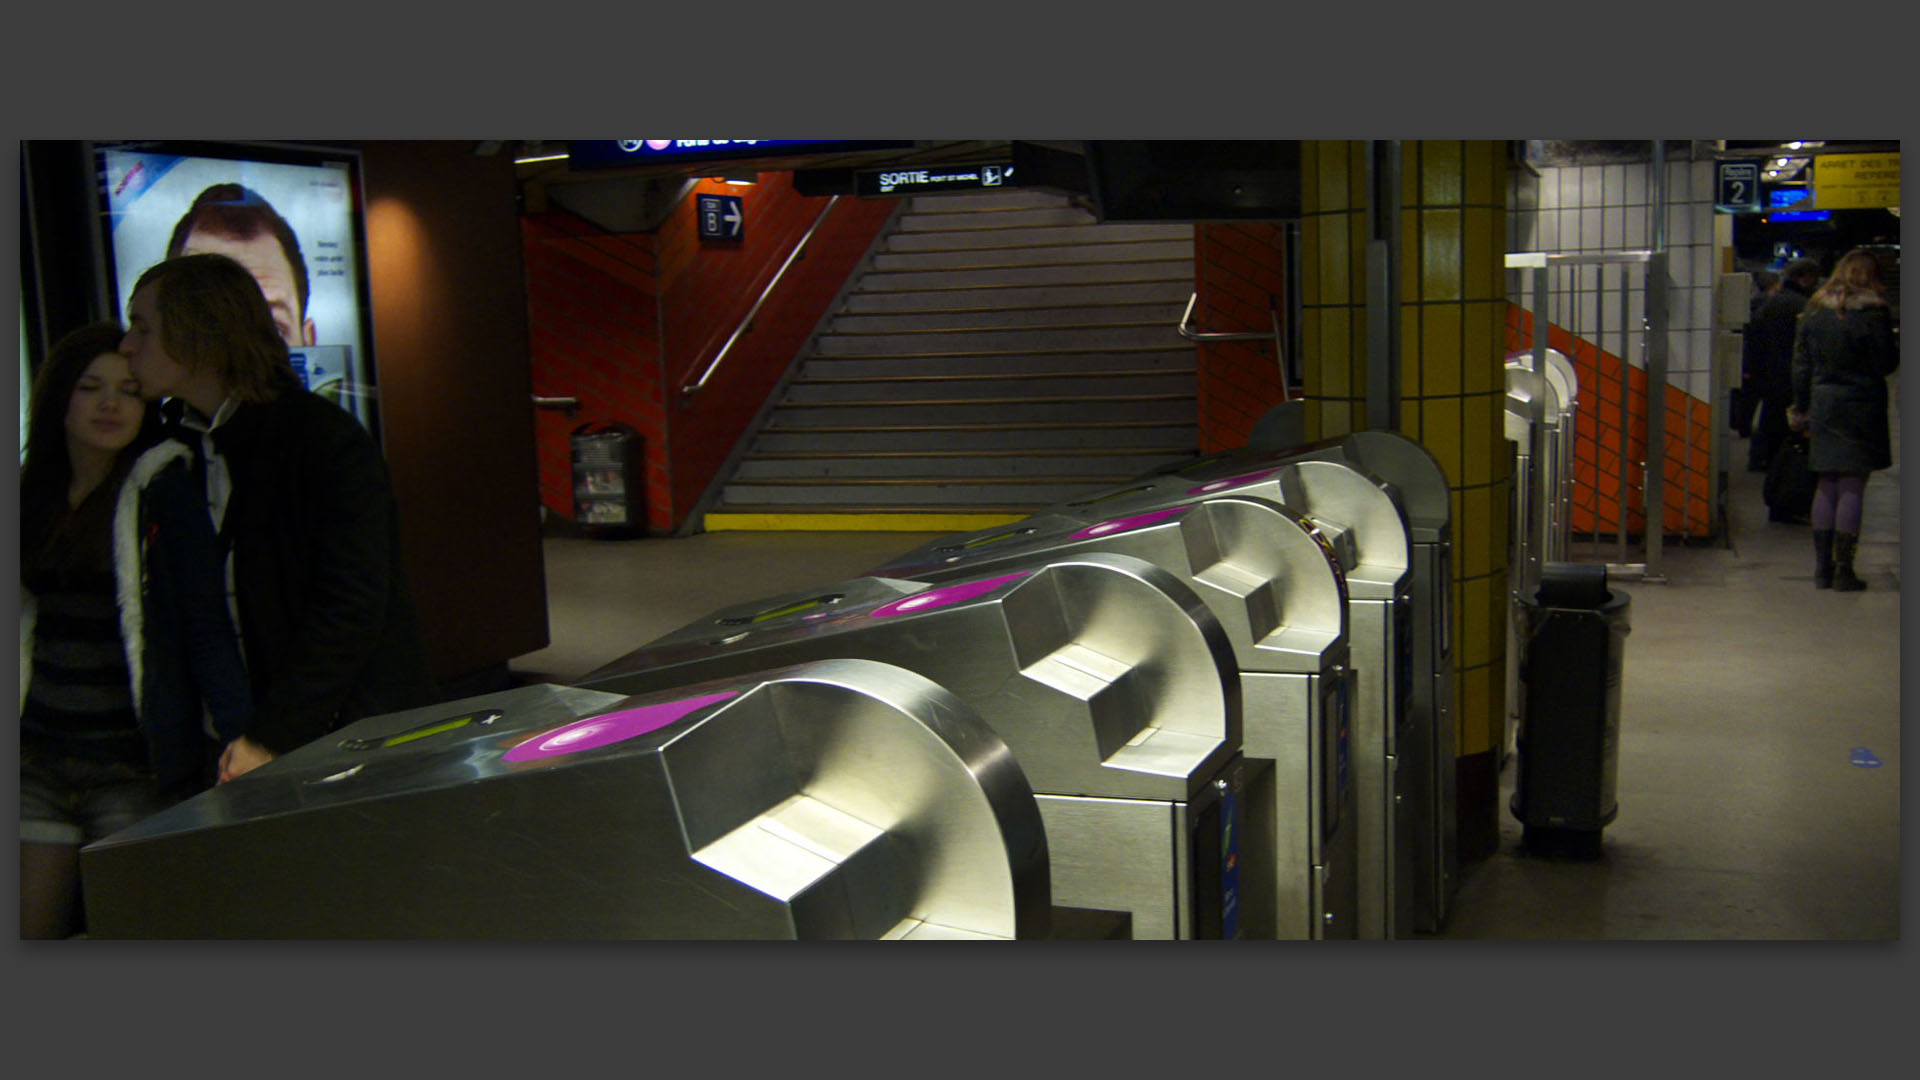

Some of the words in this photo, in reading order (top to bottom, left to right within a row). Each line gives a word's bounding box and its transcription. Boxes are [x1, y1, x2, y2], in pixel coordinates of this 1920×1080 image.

[1860, 159, 1881, 168] DES
[879, 171, 929, 185] SORTIE
[1730, 181, 1745, 203] 2
